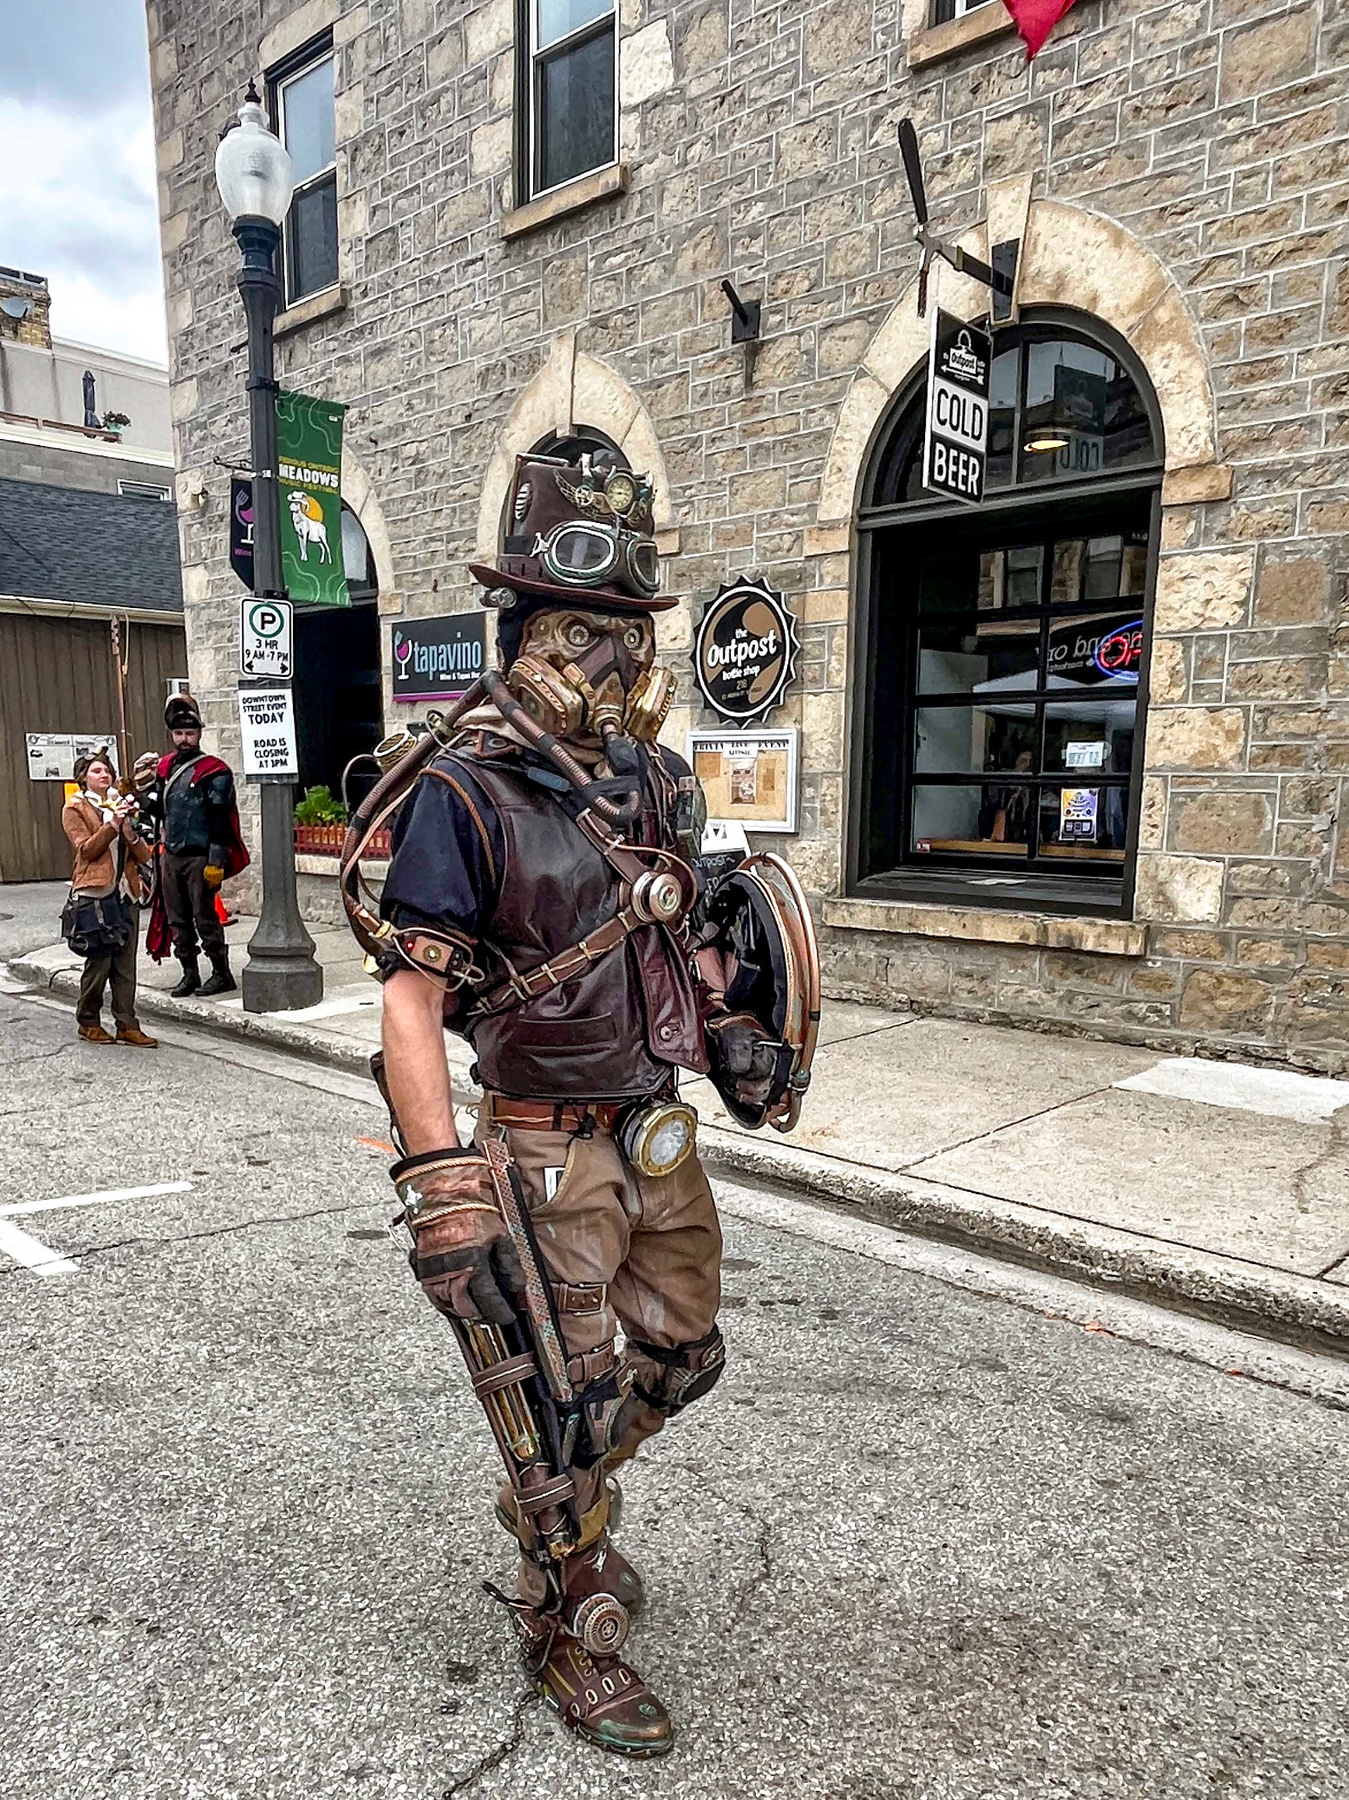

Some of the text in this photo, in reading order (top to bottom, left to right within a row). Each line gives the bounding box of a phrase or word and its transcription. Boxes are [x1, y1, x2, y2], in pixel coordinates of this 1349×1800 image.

[937, 387, 984, 442] COLD
[279, 462, 339, 488] MEADOWS
[933, 441, 980, 497] BEER
[260, 611, 277, 630] P
[735, 628, 748, 639] the
[255, 638, 279, 650] 3 HR
[707, 629, 778, 668] Outpost
[245, 648, 251, 659] 9
[252, 650, 265, 661] AM
[277, 651, 289, 662] PM
[413, 631, 482, 681] tapavino
[743, 665, 761, 677] shop
[242, 693, 287, 705] DOWNTOWN
[243, 702, 288, 713] STREET EVENT
[248, 711, 285, 725] TODAY
[254, 737, 287, 748] ROAD IS
[254, 747, 289, 759] CLOSING
[259, 759, 269, 769] AT
